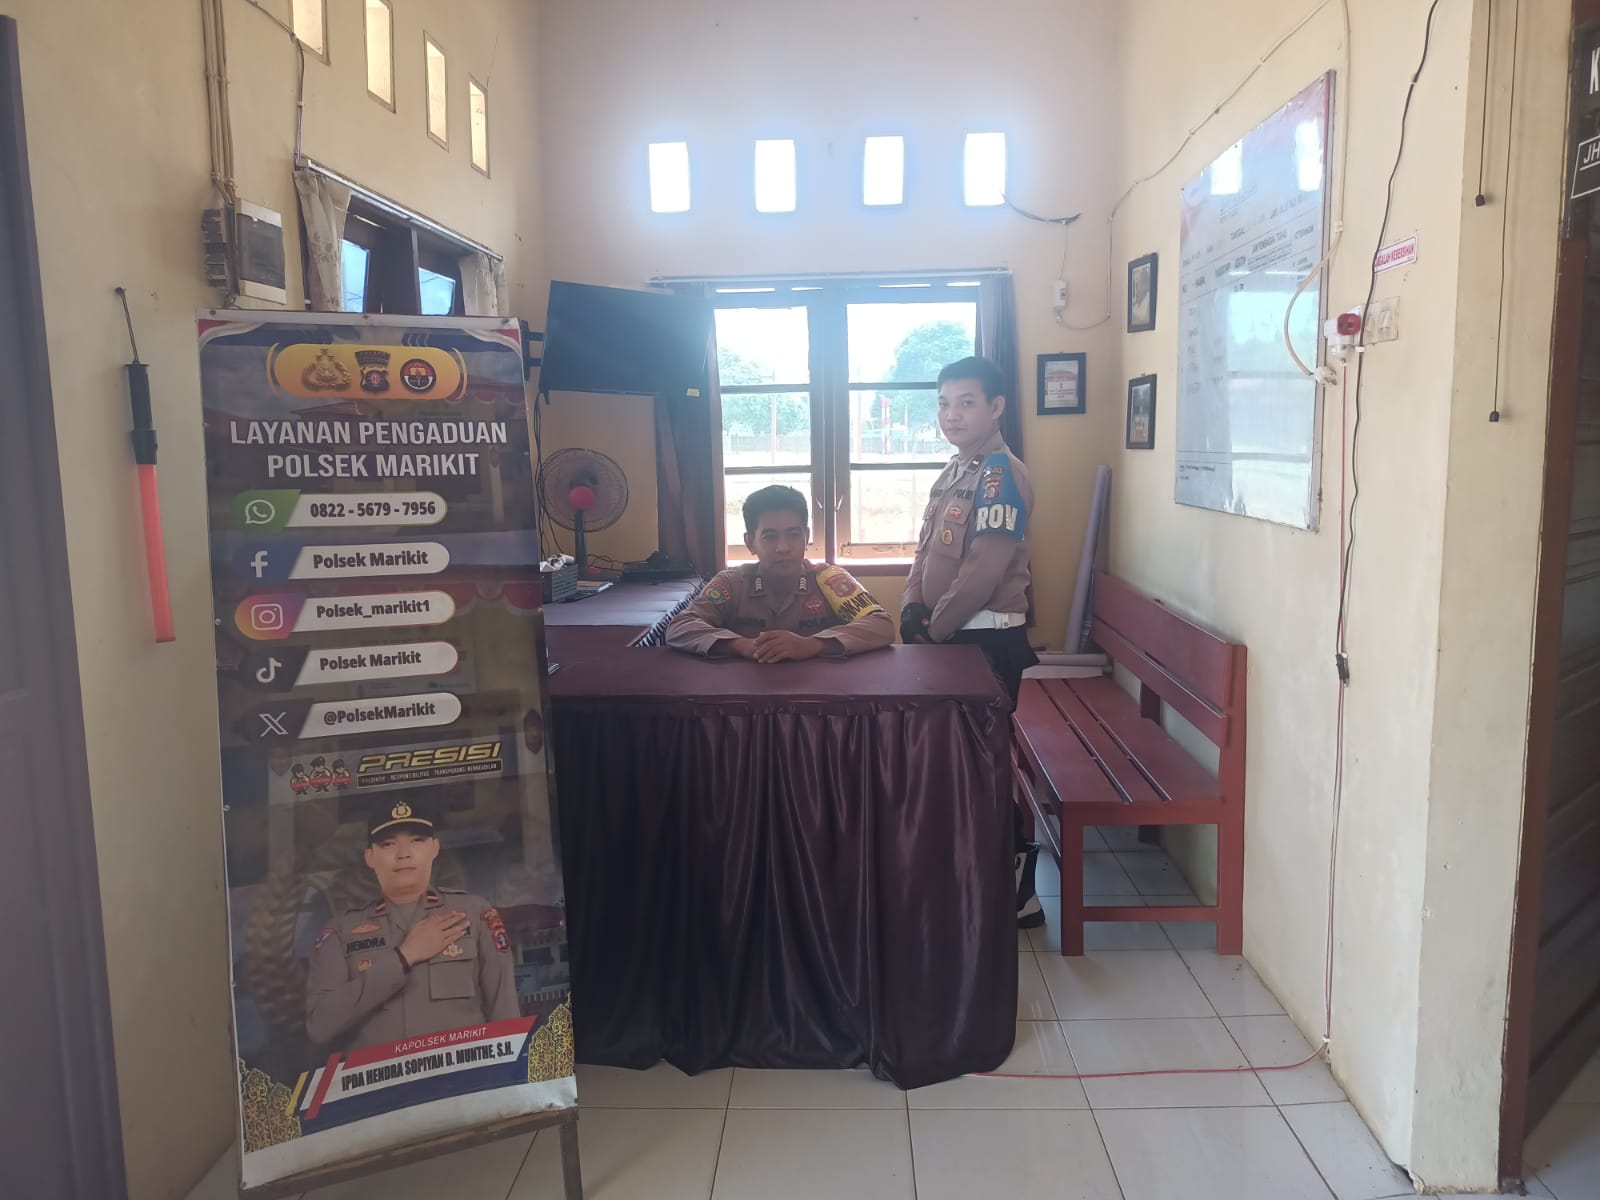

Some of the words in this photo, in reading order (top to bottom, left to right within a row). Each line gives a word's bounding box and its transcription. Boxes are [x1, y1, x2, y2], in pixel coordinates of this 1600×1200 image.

[229, 420, 351, 445] LAYANAN
[359, 420, 507, 444] PENGADUAN
[267, 453, 369, 478] POLSEK
[376, 452, 479, 477] MARIKIT
[310, 502, 345, 518] 0822
[357, 502, 391, 517] 5679
[402, 501, 436, 516] 7956
[313, 553, 367, 569] Polsek
[370, 550, 428, 567] Marikit
[316, 599, 430, 619] Polsek_marikit1
[319, 655, 367, 671] Polsek
[369, 650, 422, 668] Marikit
[323, 702, 436, 725] @PolsekMarikit
[357, 742, 502, 774] PRESISI
[346, 936, 386, 954] HENDRA
[395, 1035, 446, 1053] KAPOLSEK
[448, 1027, 488, 1043] MARIKIT
[342, 1072, 365, 1092] IPDA
[366, 1066, 404, 1088] HENDRA
[405, 1058, 444, 1081] SOPIYAN
[445, 1056, 455, 1072] D.
[496, 1041, 514, 1060] S.H.
